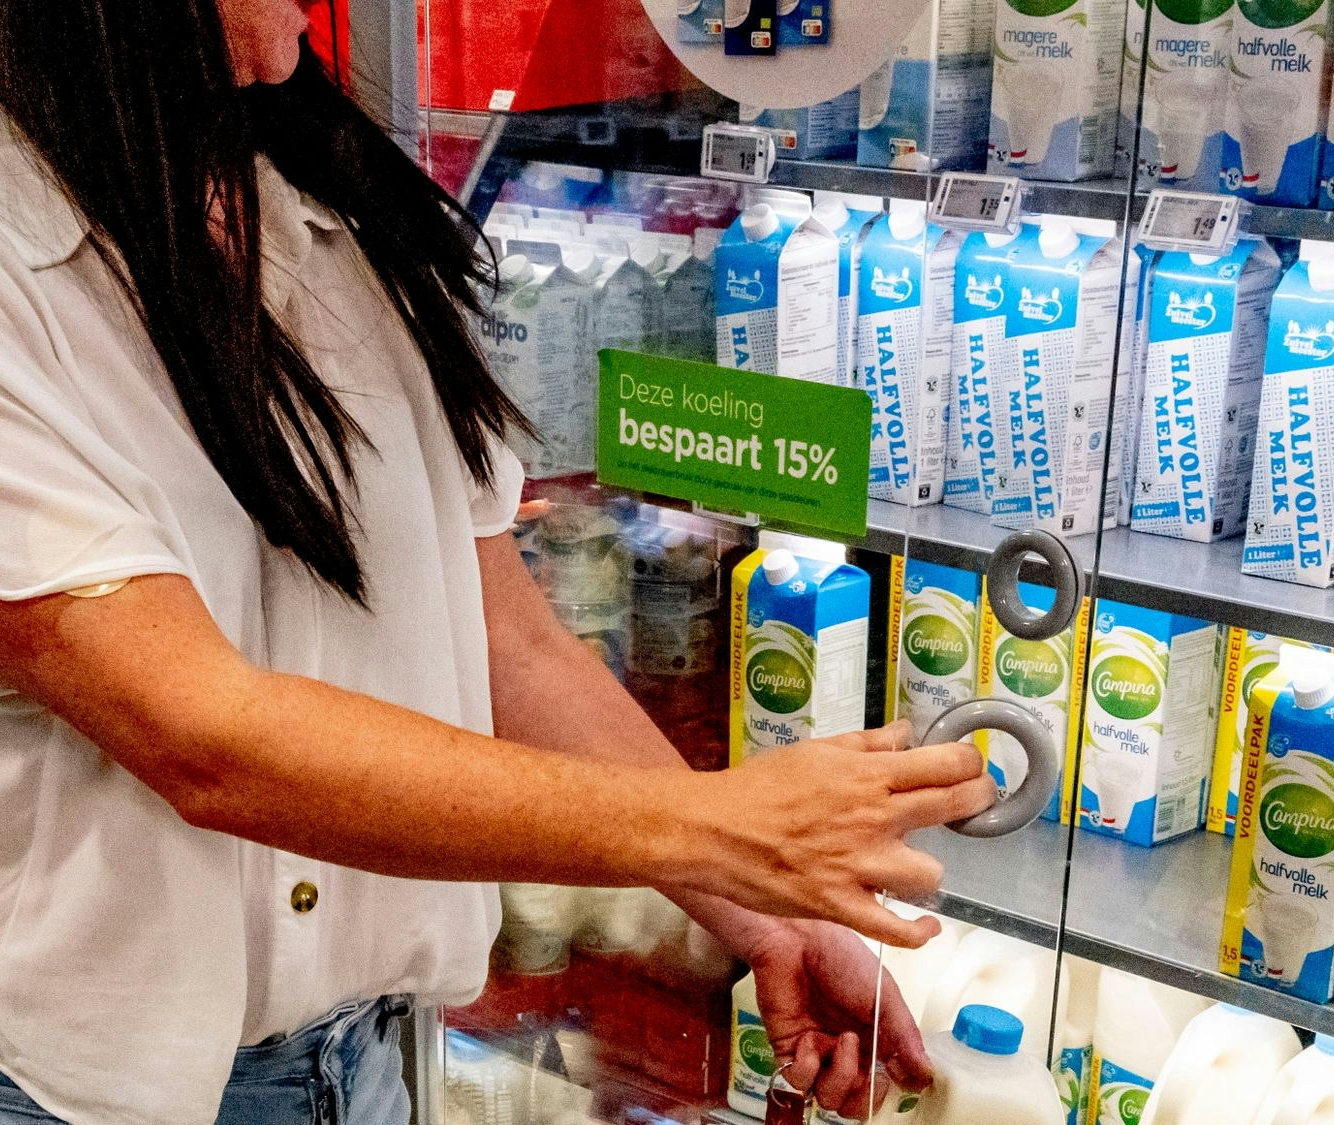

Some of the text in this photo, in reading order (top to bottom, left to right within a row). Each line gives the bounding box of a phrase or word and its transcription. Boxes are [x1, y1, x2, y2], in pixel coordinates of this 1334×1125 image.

[1002, 28, 1058, 58] magere
[1035, 36, 1075, 60] melk
[1155, 36, 1210, 59] magere
[1237, 37, 1297, 59] halfvolle
[1187, 52, 1226, 68] melk
[1271, 55, 1312, 73] melk
[619, 373, 764, 429] Deze koeling
[876, 325, 911, 490] HALFVOLLE
[958, 374, 974, 450] MELK
[1008, 390, 1027, 469] MELK
[1021, 348, 1056, 519] HALFVOLLE
[1154, 394, 1175, 475] MELK
[1170, 353, 1206, 525] HALFVOLLE
[619, 408, 762, 471] bespaart
[774, 438, 838, 486] 15%
[1254, 549, 1277, 561] Liter
[732, 590, 744, 701] VOORDEELPAK
[907, 629, 964, 657] Campina
[1000, 650, 1060, 676] Campina
[749, 663, 808, 694] Campina
[1096, 670, 1157, 701] Campina
[1093, 721, 1140, 743] halfvolle
[1238, 712, 1265, 839] VOORDEELPAK
[1260, 859, 1316, 885] halfvolle
[1292, 881, 1329, 900] melk
